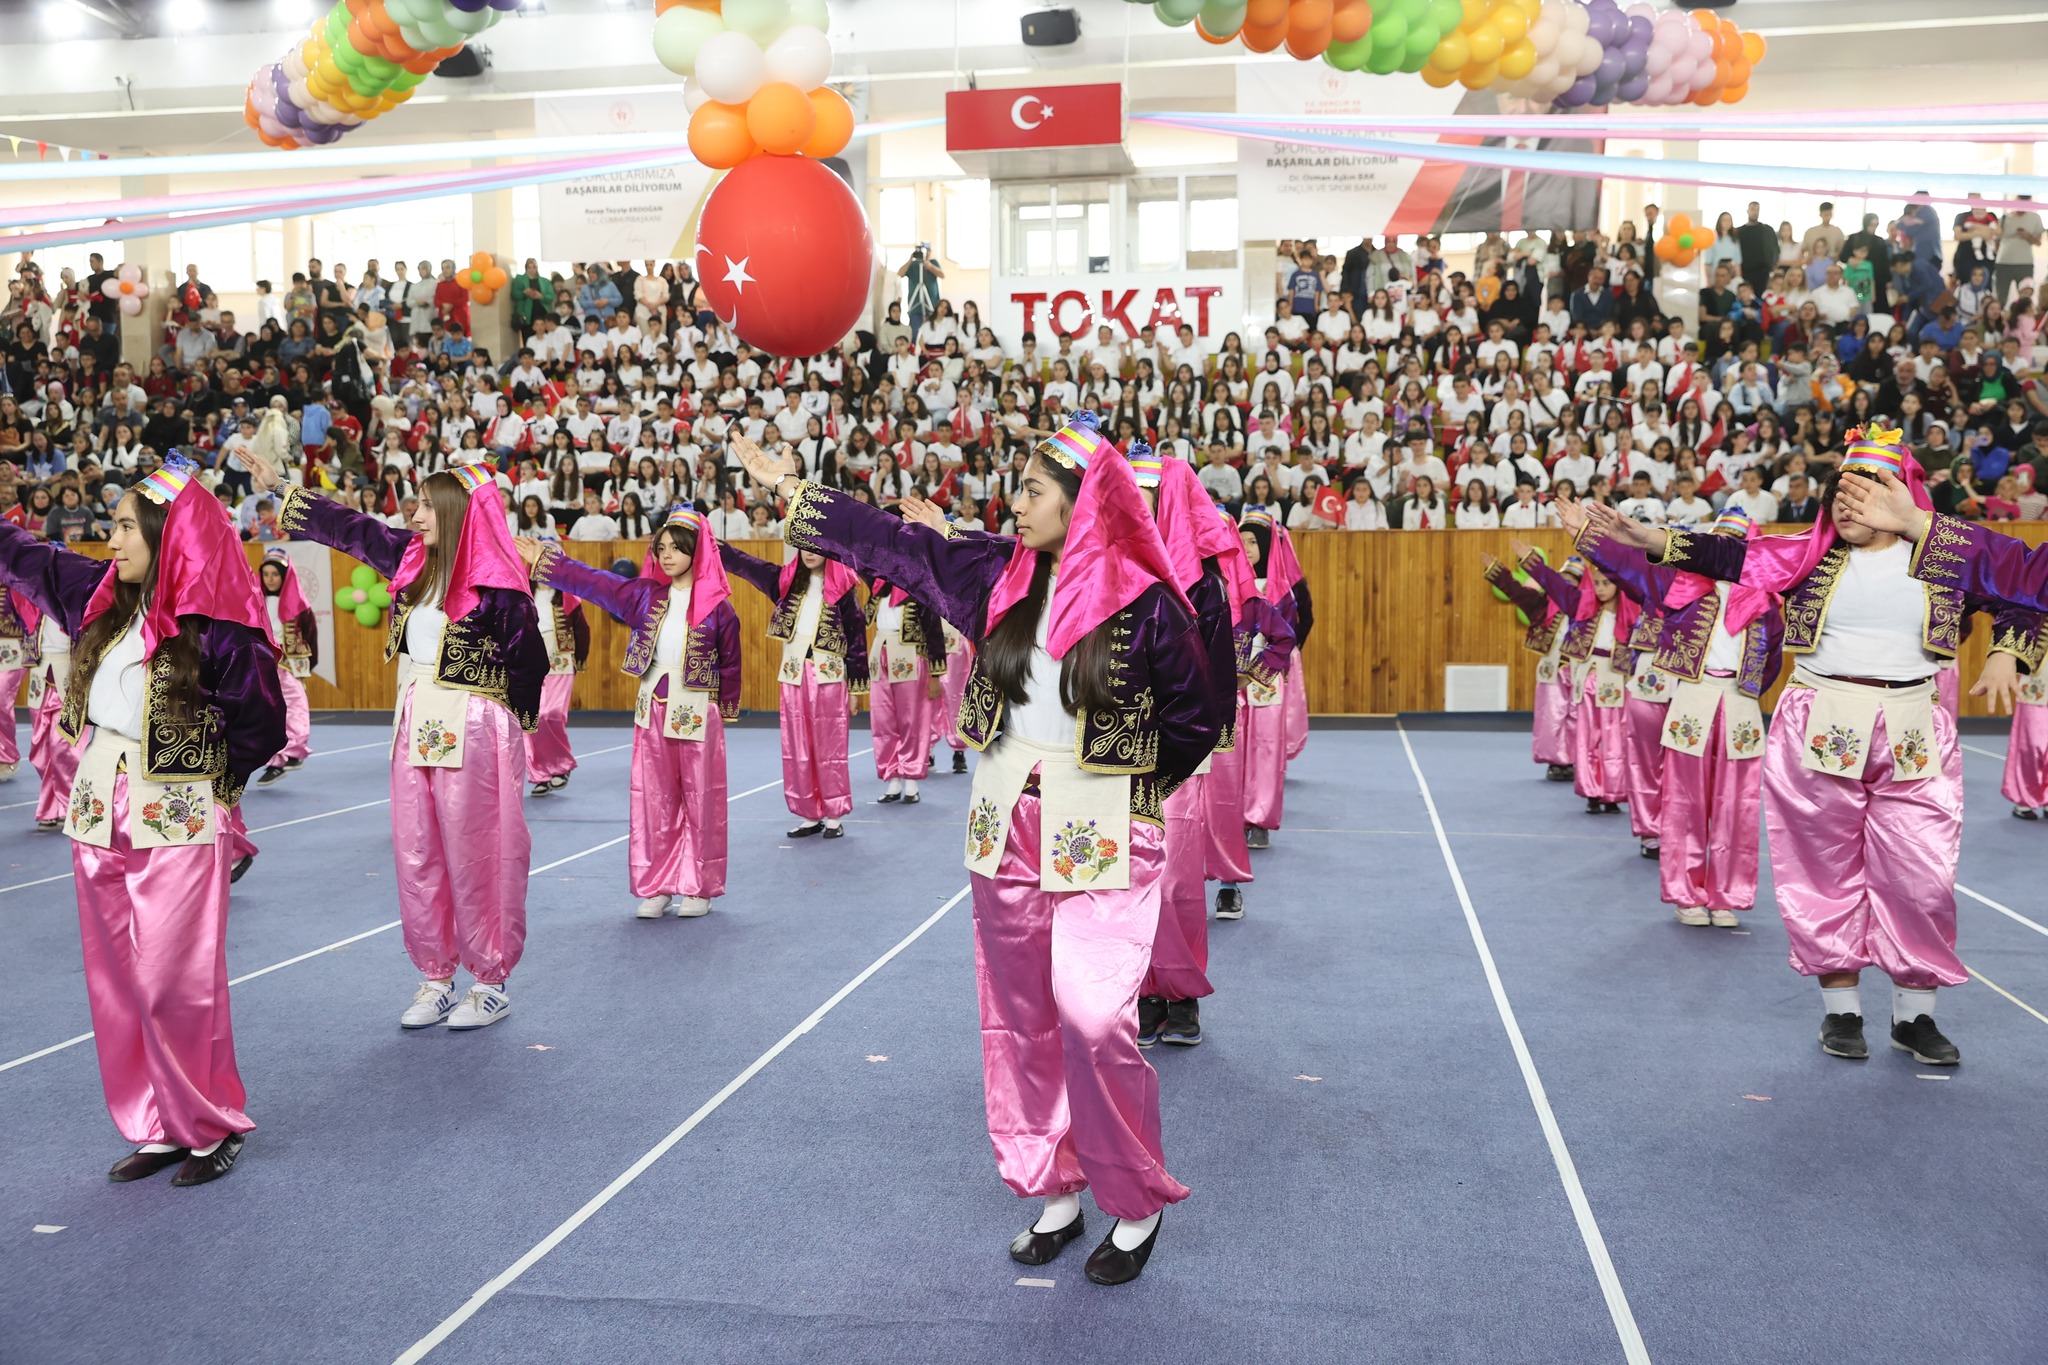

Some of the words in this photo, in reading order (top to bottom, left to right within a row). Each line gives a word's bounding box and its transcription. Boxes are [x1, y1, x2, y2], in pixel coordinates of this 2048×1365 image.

[1266, 157, 1330, 169] BAŞARILAR
[1332, 154, 1398, 166] DİLİYORUM
[565, 184, 623, 198] BAŞARILAR
[625, 182, 683, 194] DİLİYORUM
[629, 205, 664, 214] ERDOĞAN
[1011, 286, 1223, 341] TOKAT
